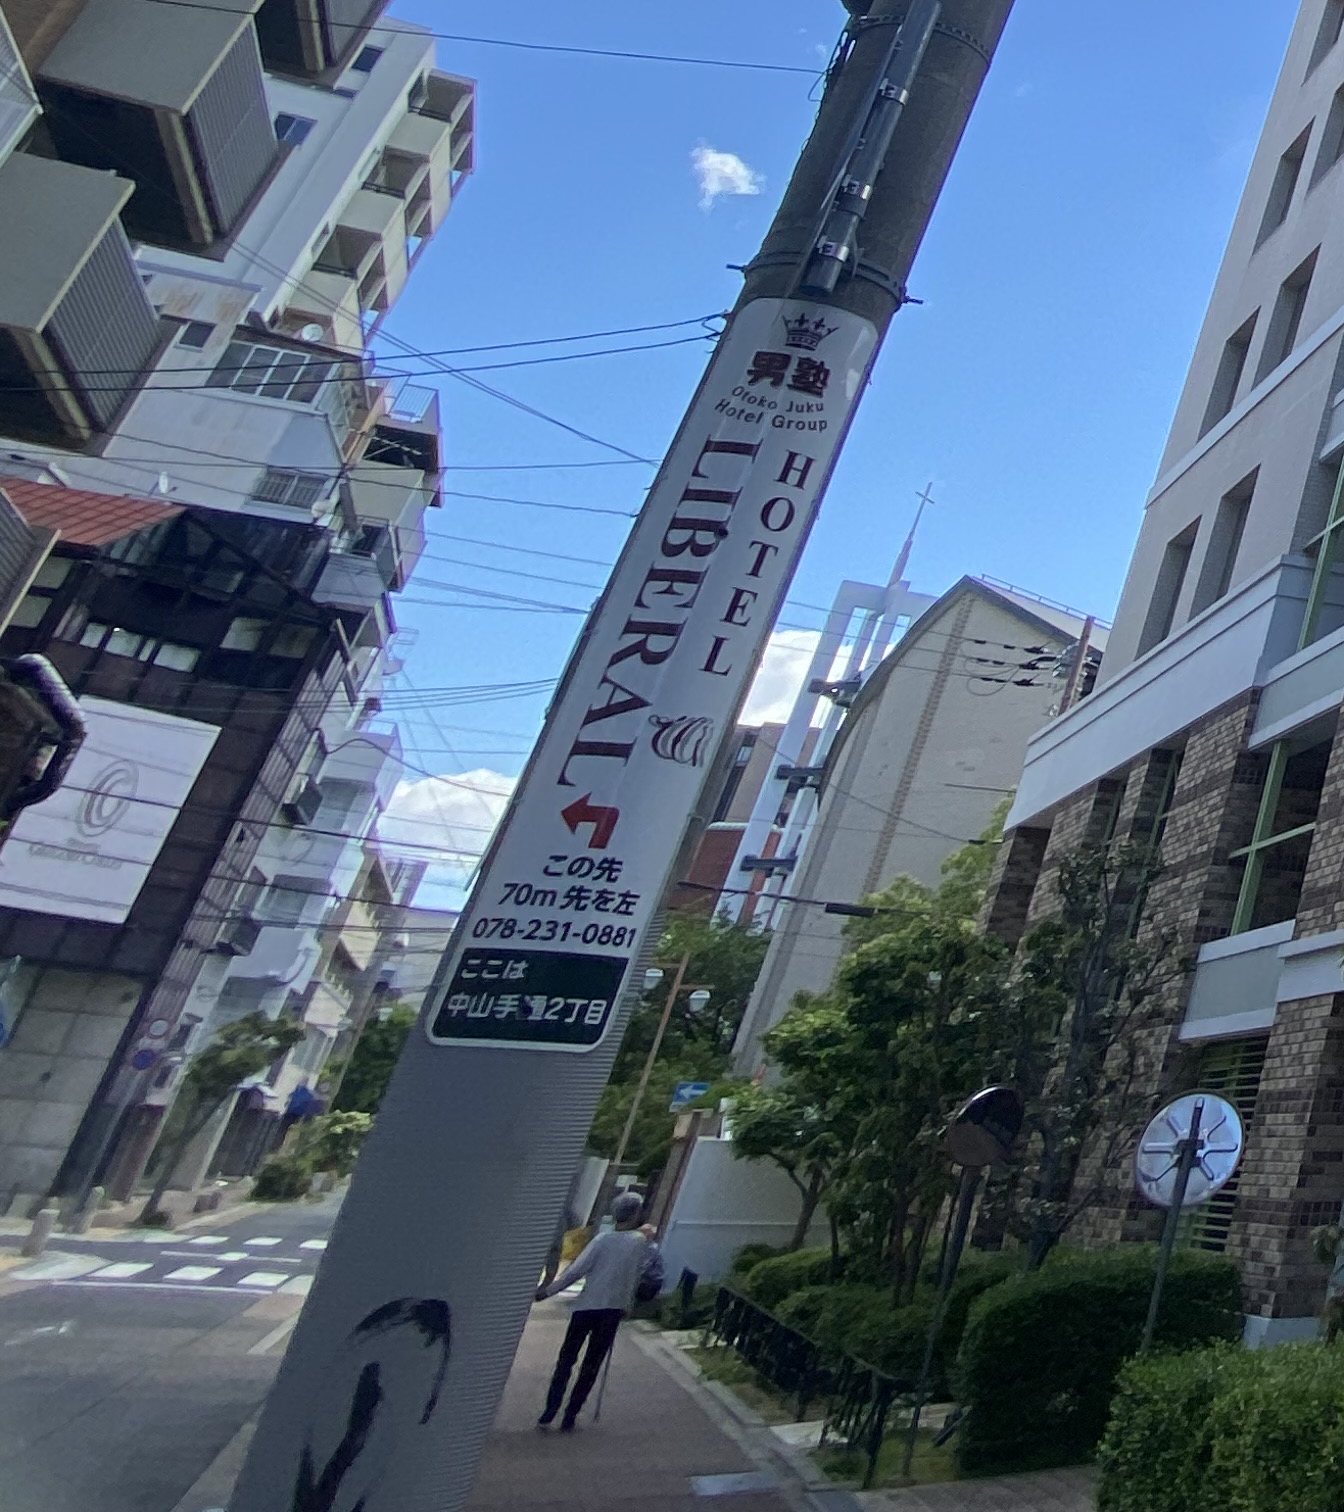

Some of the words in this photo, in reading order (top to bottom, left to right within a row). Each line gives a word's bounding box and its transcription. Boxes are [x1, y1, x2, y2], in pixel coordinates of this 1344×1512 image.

[746, 351, 831, 398] 男塾
[732, 386, 778, 409] Otoko
[785, 401, 824, 413] Juku
[715, 399, 764, 424] Hotel
[771, 415, 828, 432] Group
[700, 449, 816, 677] HOTEL
[557, 435, 763, 787] LIBERAL
[542, 854, 624, 883] この先
[472, 918, 637, 948] 078-231-0881
[461, 959, 529, 979] ここは
